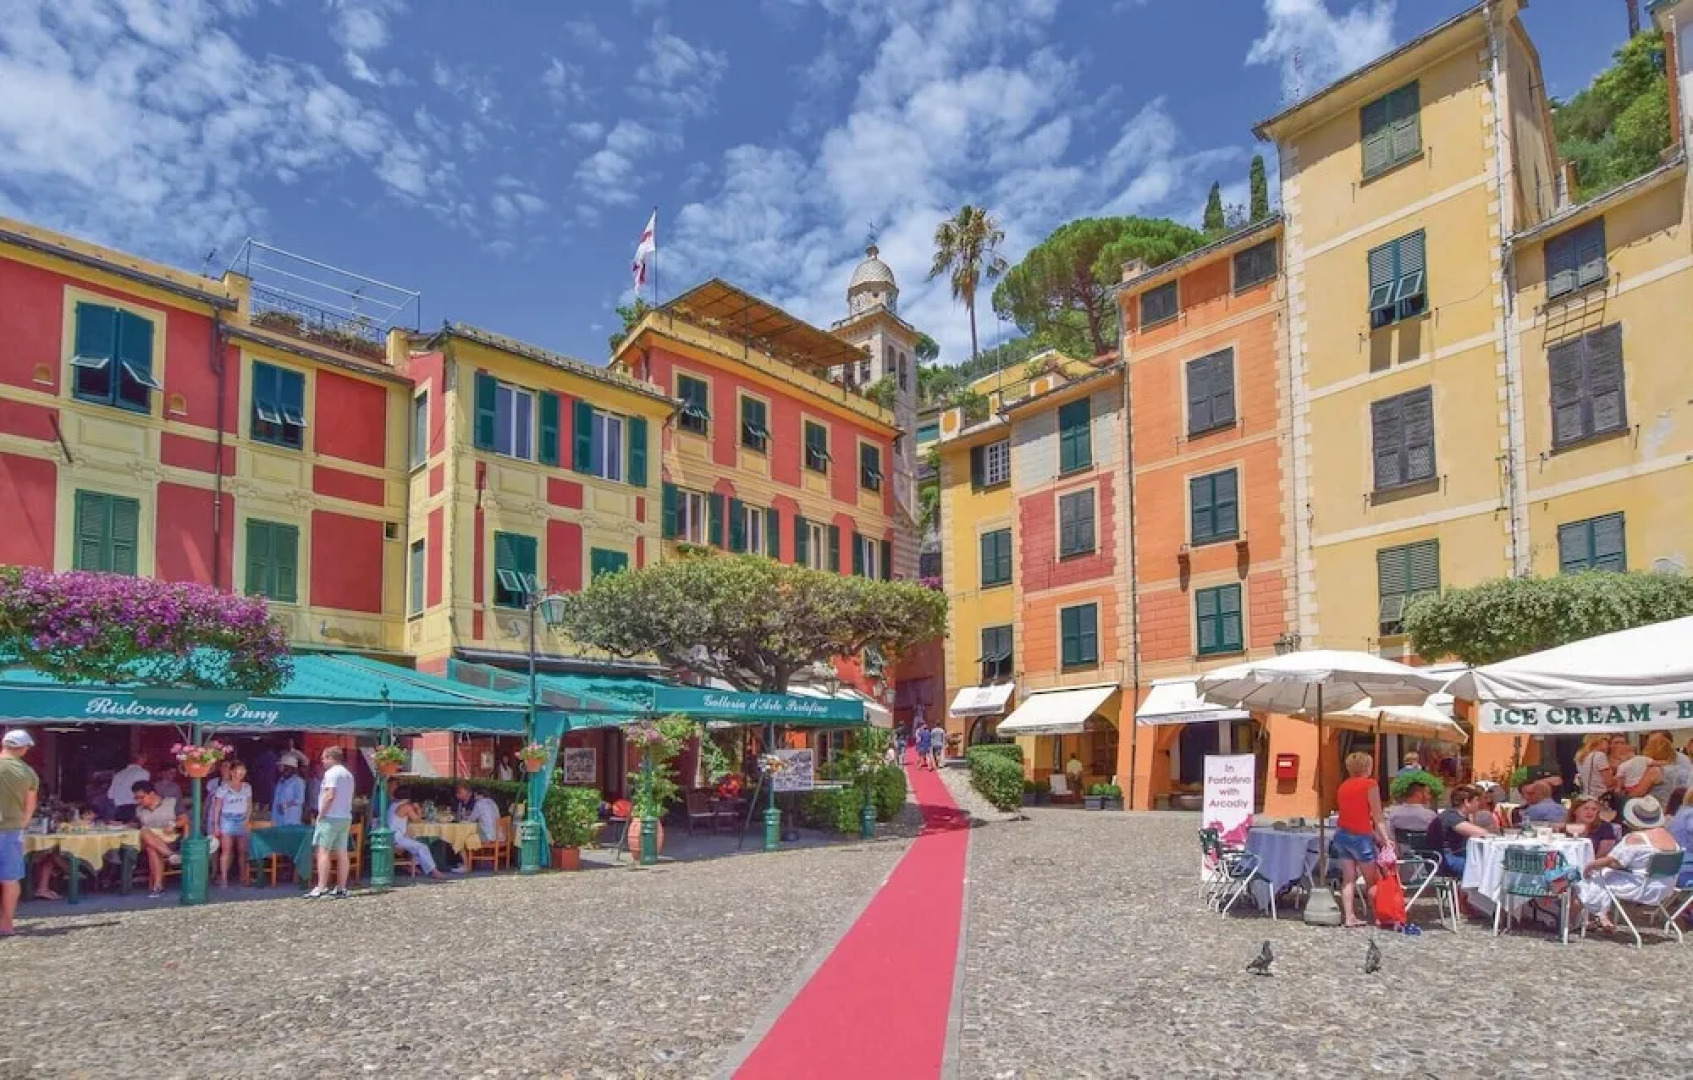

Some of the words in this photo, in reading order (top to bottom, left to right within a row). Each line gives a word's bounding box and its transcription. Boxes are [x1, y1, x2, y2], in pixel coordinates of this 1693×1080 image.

[85, 698, 199, 717] Ristorante
[225, 703, 279, 725] Puny
[703, 694, 746, 709] Galleria
[785, 699, 829, 716] Portofino
[1492, 708, 1538, 726] ICE
[1545, 703, 1652, 726] CREAM
[1224, 763, 1234, 772] In
[1208, 775, 1251, 784] Portofino
[1219, 787, 1239, 796] with
